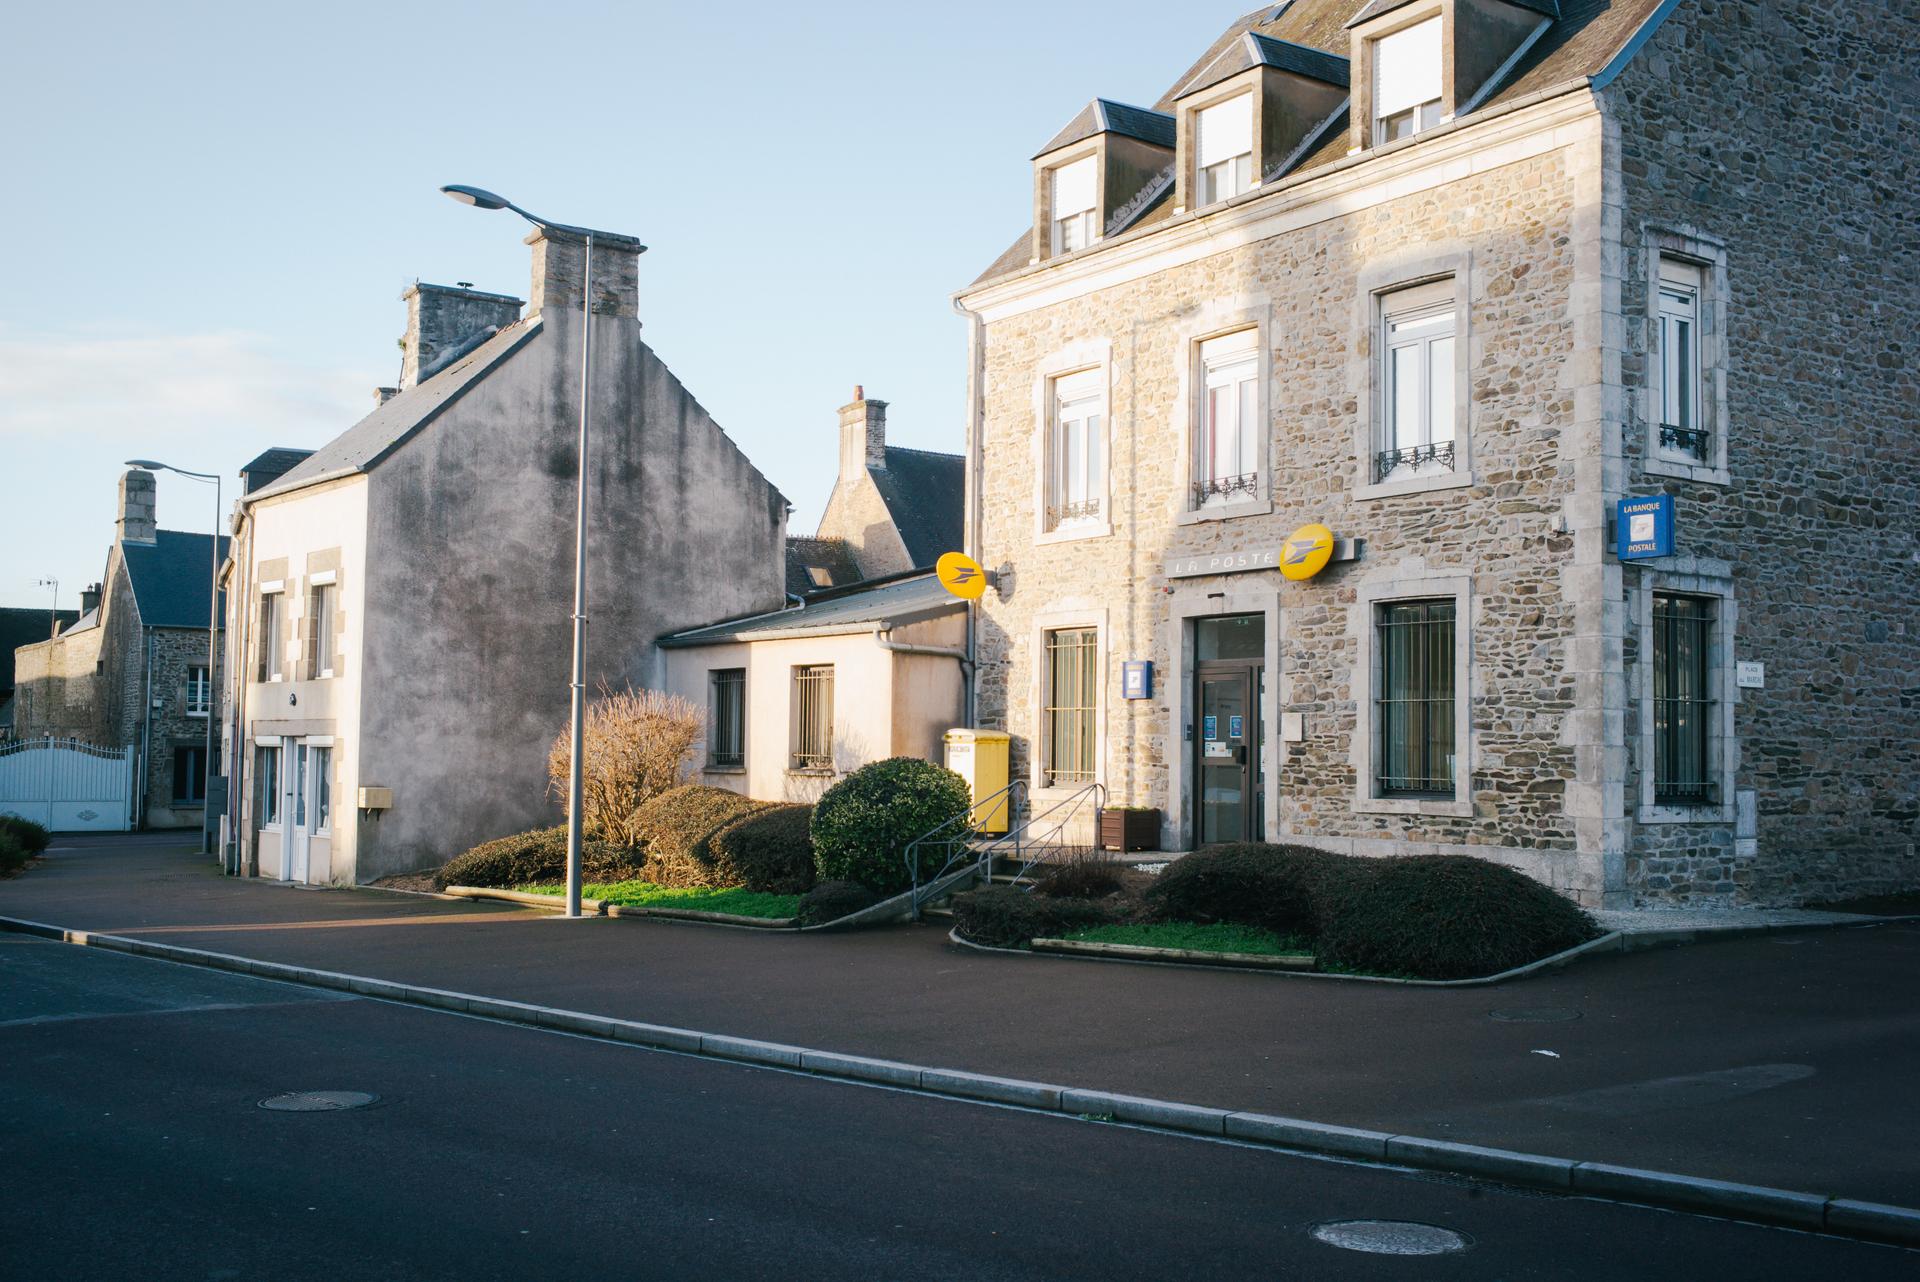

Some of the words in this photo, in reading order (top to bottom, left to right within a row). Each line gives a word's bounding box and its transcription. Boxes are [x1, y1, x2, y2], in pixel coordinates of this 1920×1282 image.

[1633, 502, 1660, 512] BANQUE
[1628, 543, 1656, 552] POSTALE
[1175, 561, 1198, 573] LA
[1210, 552, 1273, 569] POSTE
